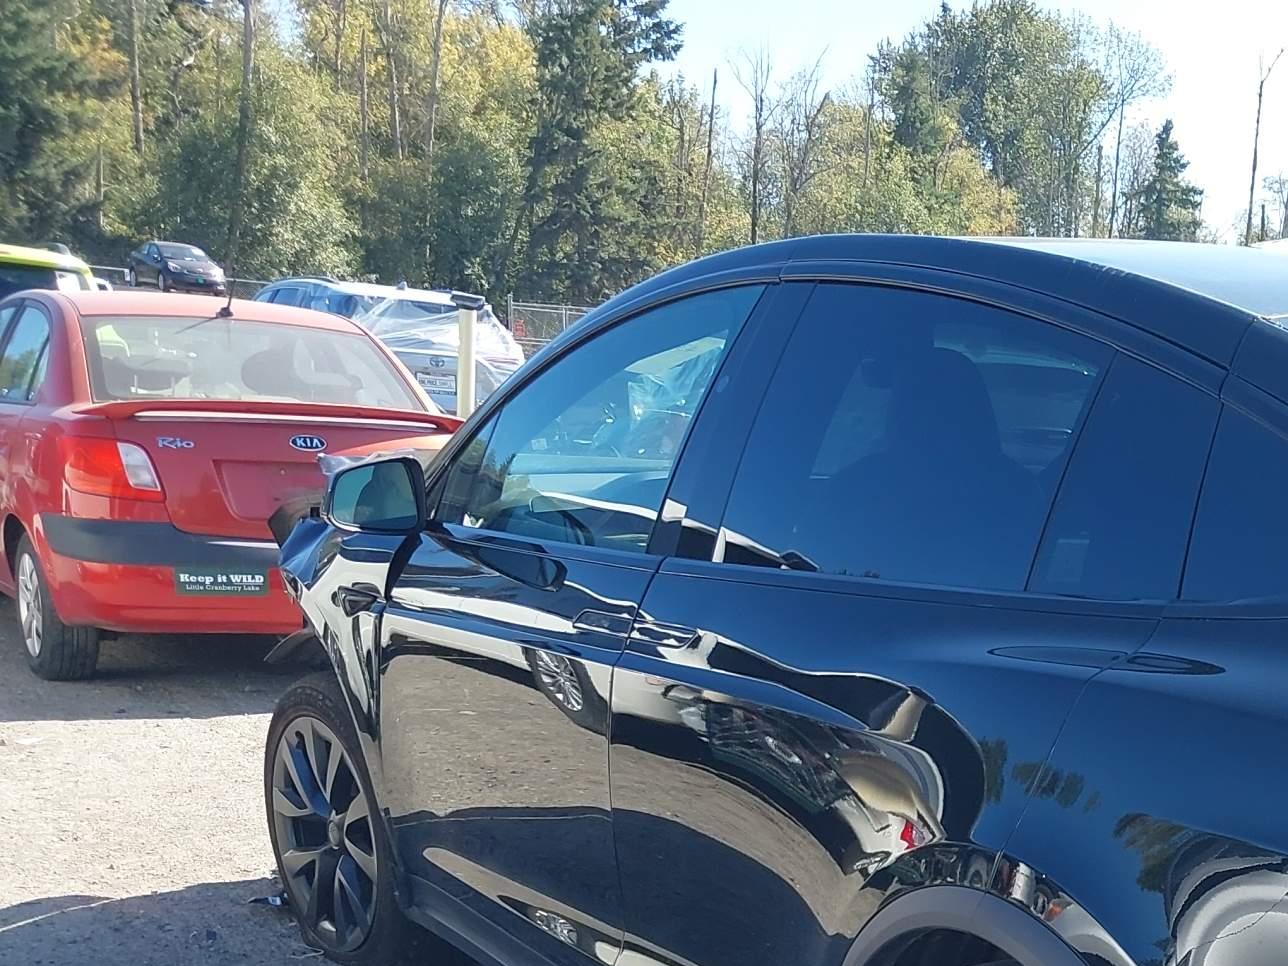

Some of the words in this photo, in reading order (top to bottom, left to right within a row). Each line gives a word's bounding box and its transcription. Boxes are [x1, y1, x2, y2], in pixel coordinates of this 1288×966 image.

[157, 437, 195, 449] Rio
[296, 437, 322, 448] KIA
[179, 573, 214, 585] Keep
[217, 574, 228, 583] it
[229, 574, 264, 583] WILD
[205, 584, 242, 592] Cranberry
